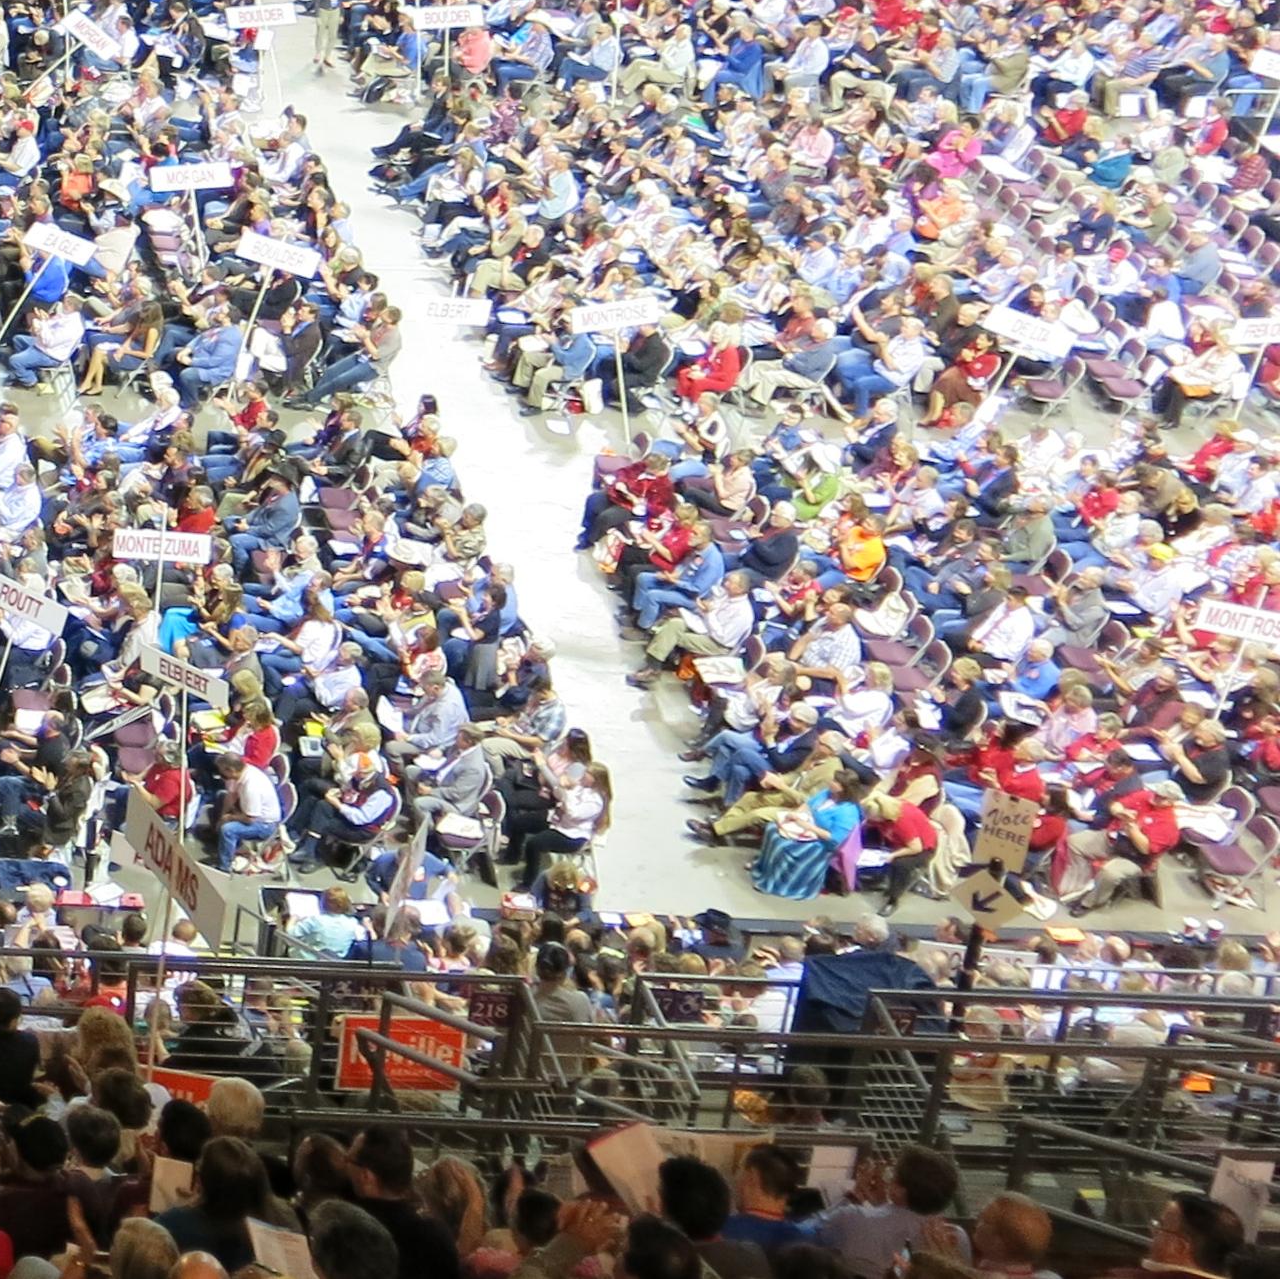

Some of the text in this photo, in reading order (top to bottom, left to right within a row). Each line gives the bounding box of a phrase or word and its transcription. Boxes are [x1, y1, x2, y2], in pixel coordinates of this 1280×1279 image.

[166, 168, 216, 184] MORGAN
[43, 234, 83, 257] EAGLE
[252, 236, 306, 269] BOULDER
[581, 302, 649, 326] MONTROSE
[114, 534, 201, 559] MONTEZUMA
[1205, 606, 1280, 639] MONTROS
[158, 658, 210, 695] ELBERT
[982, 824, 1027, 847] HERE
[143, 821, 200, 913] ADAMS
[474, 1001, 509, 1020] 218
[350, 1033, 454, 1066] Nville
